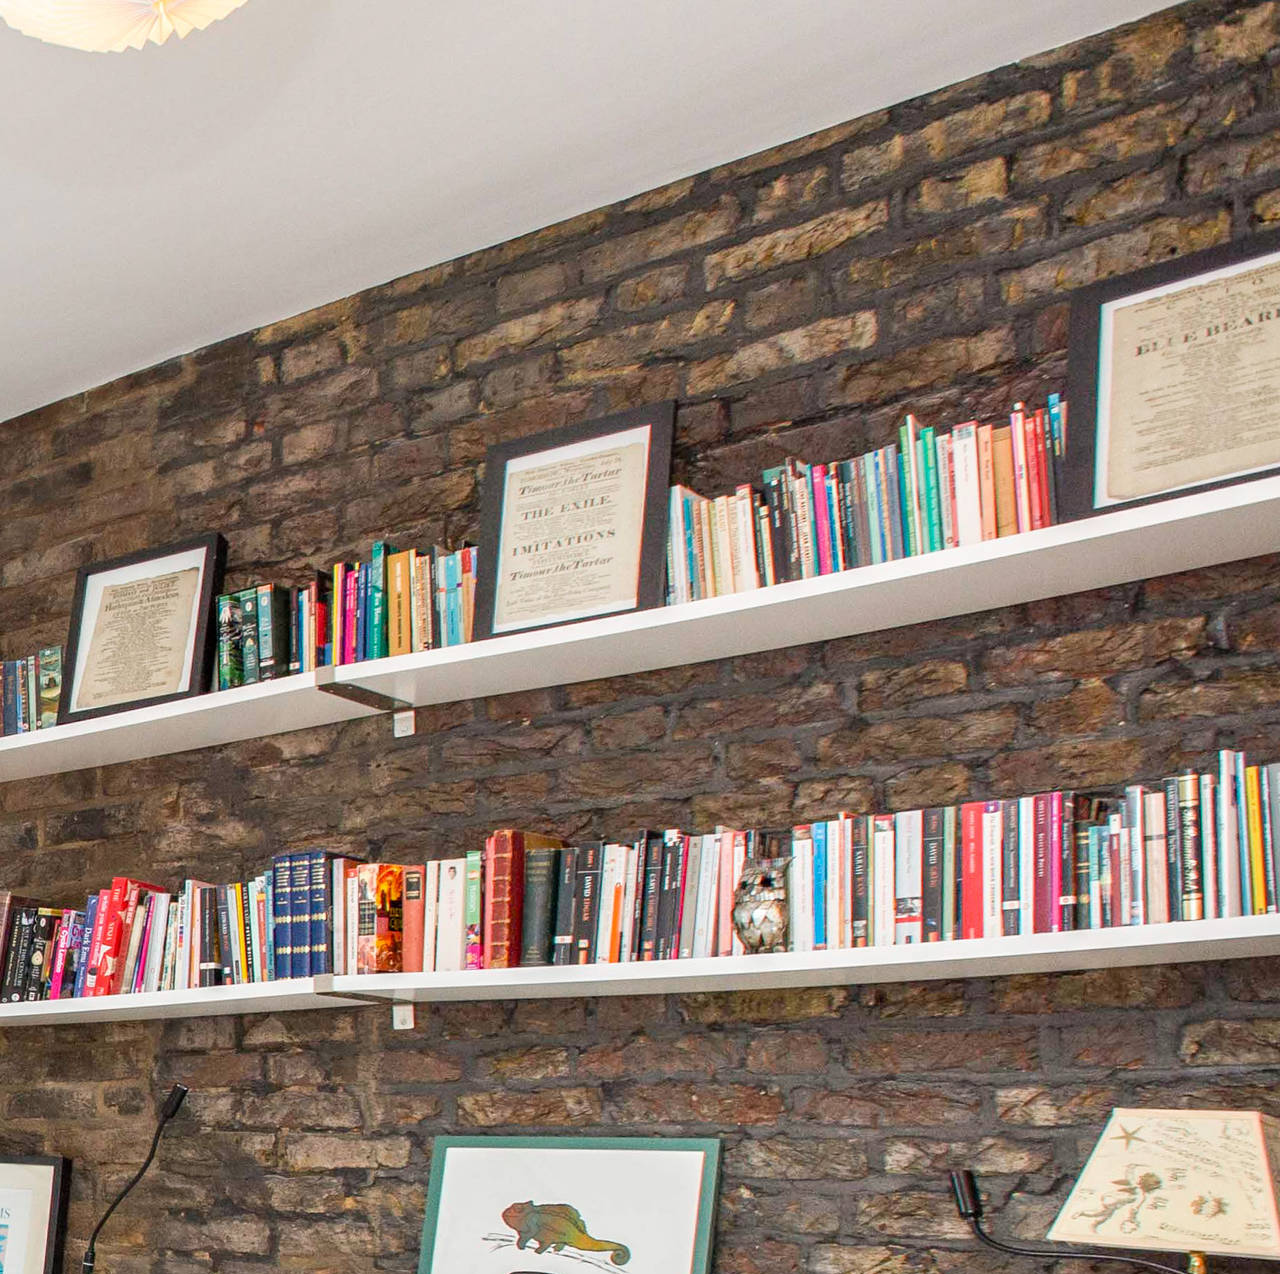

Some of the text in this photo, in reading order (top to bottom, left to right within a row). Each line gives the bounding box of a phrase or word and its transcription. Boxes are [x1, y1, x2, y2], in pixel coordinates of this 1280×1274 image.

[523, 506, 553, 520] THE
[512, 529, 615, 556] IMITATIONS
[855, 850, 864, 875] SARAH
[928, 842, 937, 864] DAVID
[583, 875, 593, 898] DAVID
[83, 927, 92, 944] Dark
[55, 949, 65, 973] London
[80, 946, 90, 963] Emu
